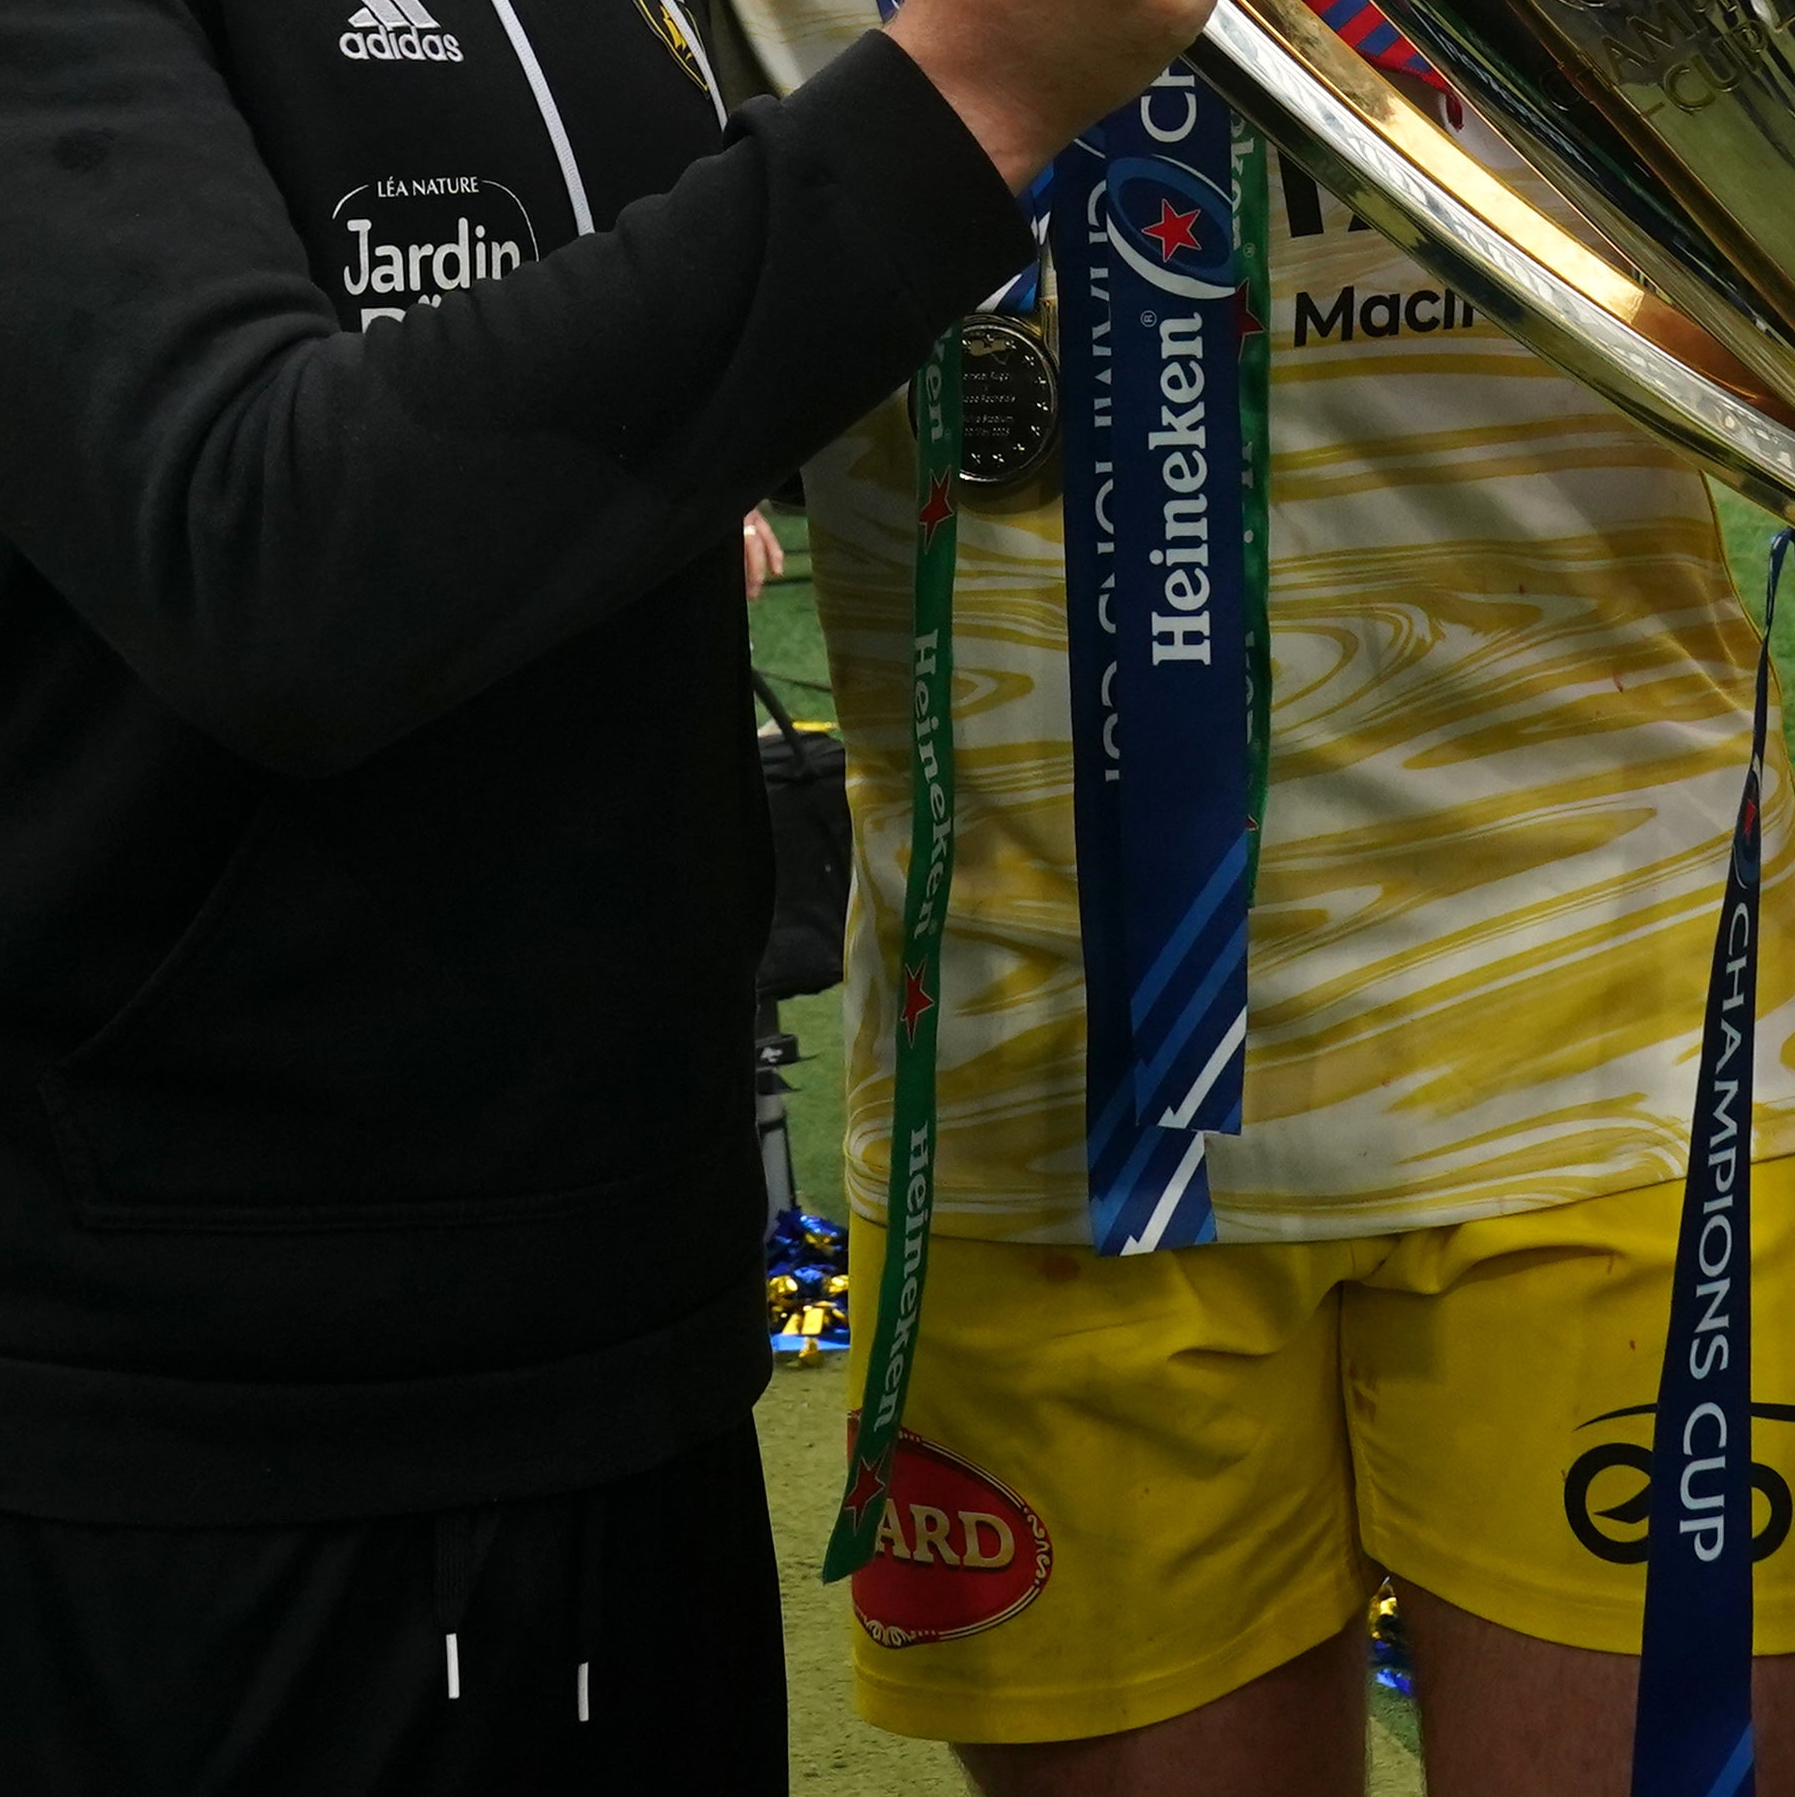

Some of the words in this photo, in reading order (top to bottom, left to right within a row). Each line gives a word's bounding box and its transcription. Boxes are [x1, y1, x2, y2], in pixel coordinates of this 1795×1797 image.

[339, 25, 465, 62] adidas
[343, 216, 521, 296] Jardin
[377, 175, 409, 197] LÉA
[412, 177, 480, 196] NATURE
[1148, 311, 1212, 667] Heineken
[914, 628, 953, 941] Heineken
[1687, 901, 1751, 1380] CHAMPIONS
[873, 1118, 931, 1434] Heineken
[874, 1497, 1018, 1573] ARD
[1679, 1401, 1728, 1564] CUP
